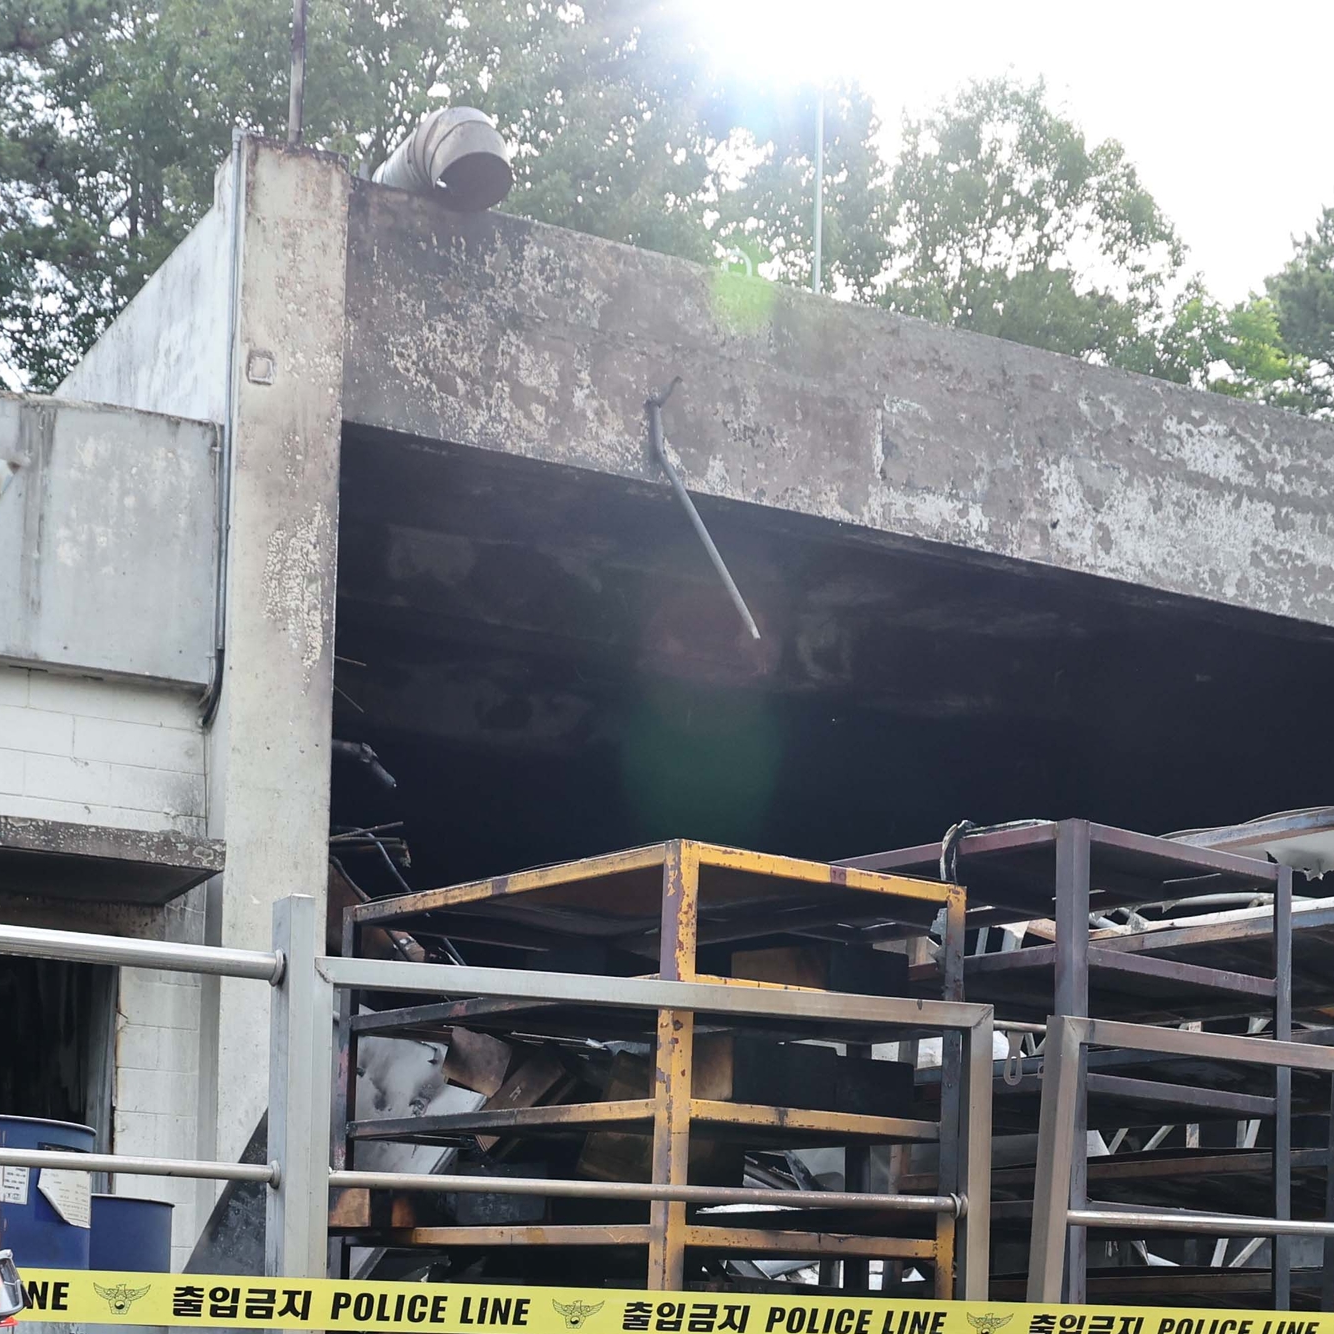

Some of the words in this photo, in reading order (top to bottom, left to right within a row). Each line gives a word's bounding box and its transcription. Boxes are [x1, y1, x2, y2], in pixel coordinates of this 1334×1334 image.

[27, 1281, 69, 1311] NE
[172, 1286, 312, 1320] 출입금지
[331, 1292, 446, 1324] POLICE
[460, 1296, 531, 1326] LINE
[622, 1301, 751, 1334] 출입금지
